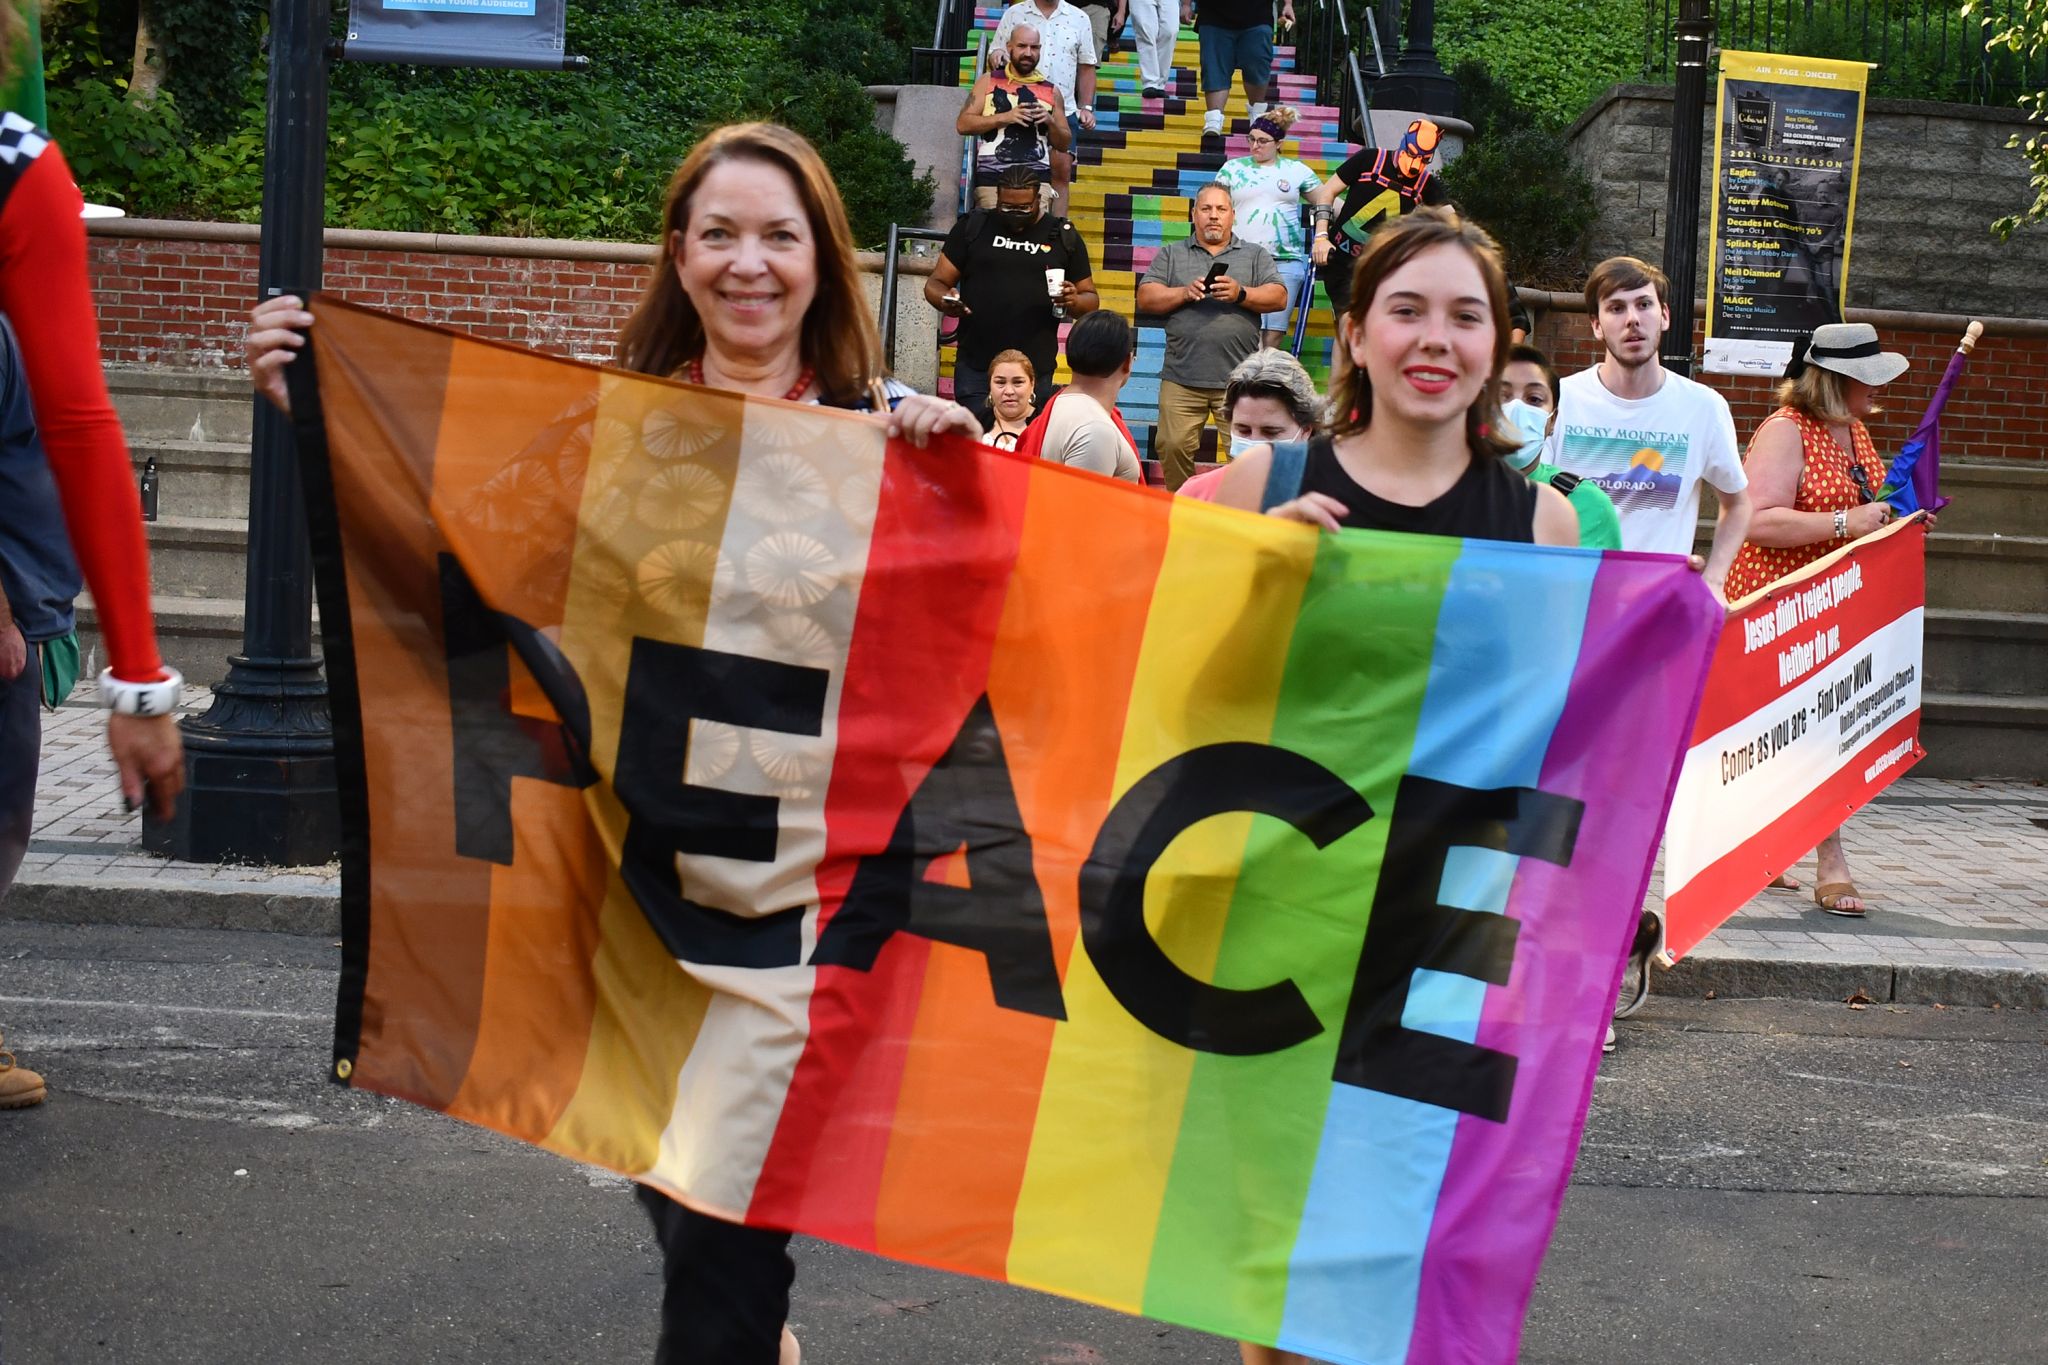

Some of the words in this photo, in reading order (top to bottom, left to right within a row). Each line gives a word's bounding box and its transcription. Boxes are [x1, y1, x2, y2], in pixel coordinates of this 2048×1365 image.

[481, 0, 529, 8] AUDIENCES
[1794, 109, 1822, 117] PURCHASE
[1795, 158, 1842, 168] SEASON
[1730, 168, 1756, 178] Eagles
[1727, 205, 1739, 213] Aug
[1728, 197, 1759, 206] Forever
[1761, 198, 1789, 210] Motown
[1727, 218, 1762, 227] Decades
[1763, 219, 1771, 227] in
[992, 236, 1040, 254] Dirrty
[1726, 239, 1751, 249] Splish
[1752, 241, 1780, 250] Splash
[1724, 268, 1741, 276] Neil
[1743, 269, 1781, 278] Diamond
[1723, 296, 1754, 305] MAGIC
[1565, 425, 1611, 437] ROCKY
[1616, 429, 1689, 443] MOUNTAIN
[1744, 612, 1775, 654] Jesus
[1776, 592, 1803, 636] didn't
[1803, 577, 1833, 621] reject
[1832, 561, 1863, 608] people.
[1779, 640, 1814, 687] Neither
[1815, 630, 1826, 664] do
[1840, 704, 1855, 735] United
[1856, 675, 1895, 721] Congregational
[1895, 664, 1914, 692] Church
[1721, 742, 1754, 786] Come
[1757, 732, 1768, 765] as
[1771, 719, 1789, 758] you
[1791, 707, 1807, 741] are
[1817, 682, 1834, 723] Find
[1835, 674, 1852, 712] your
[1853, 653, 1872, 694] WOW
[437, 552, 1586, 1124] PEACE
